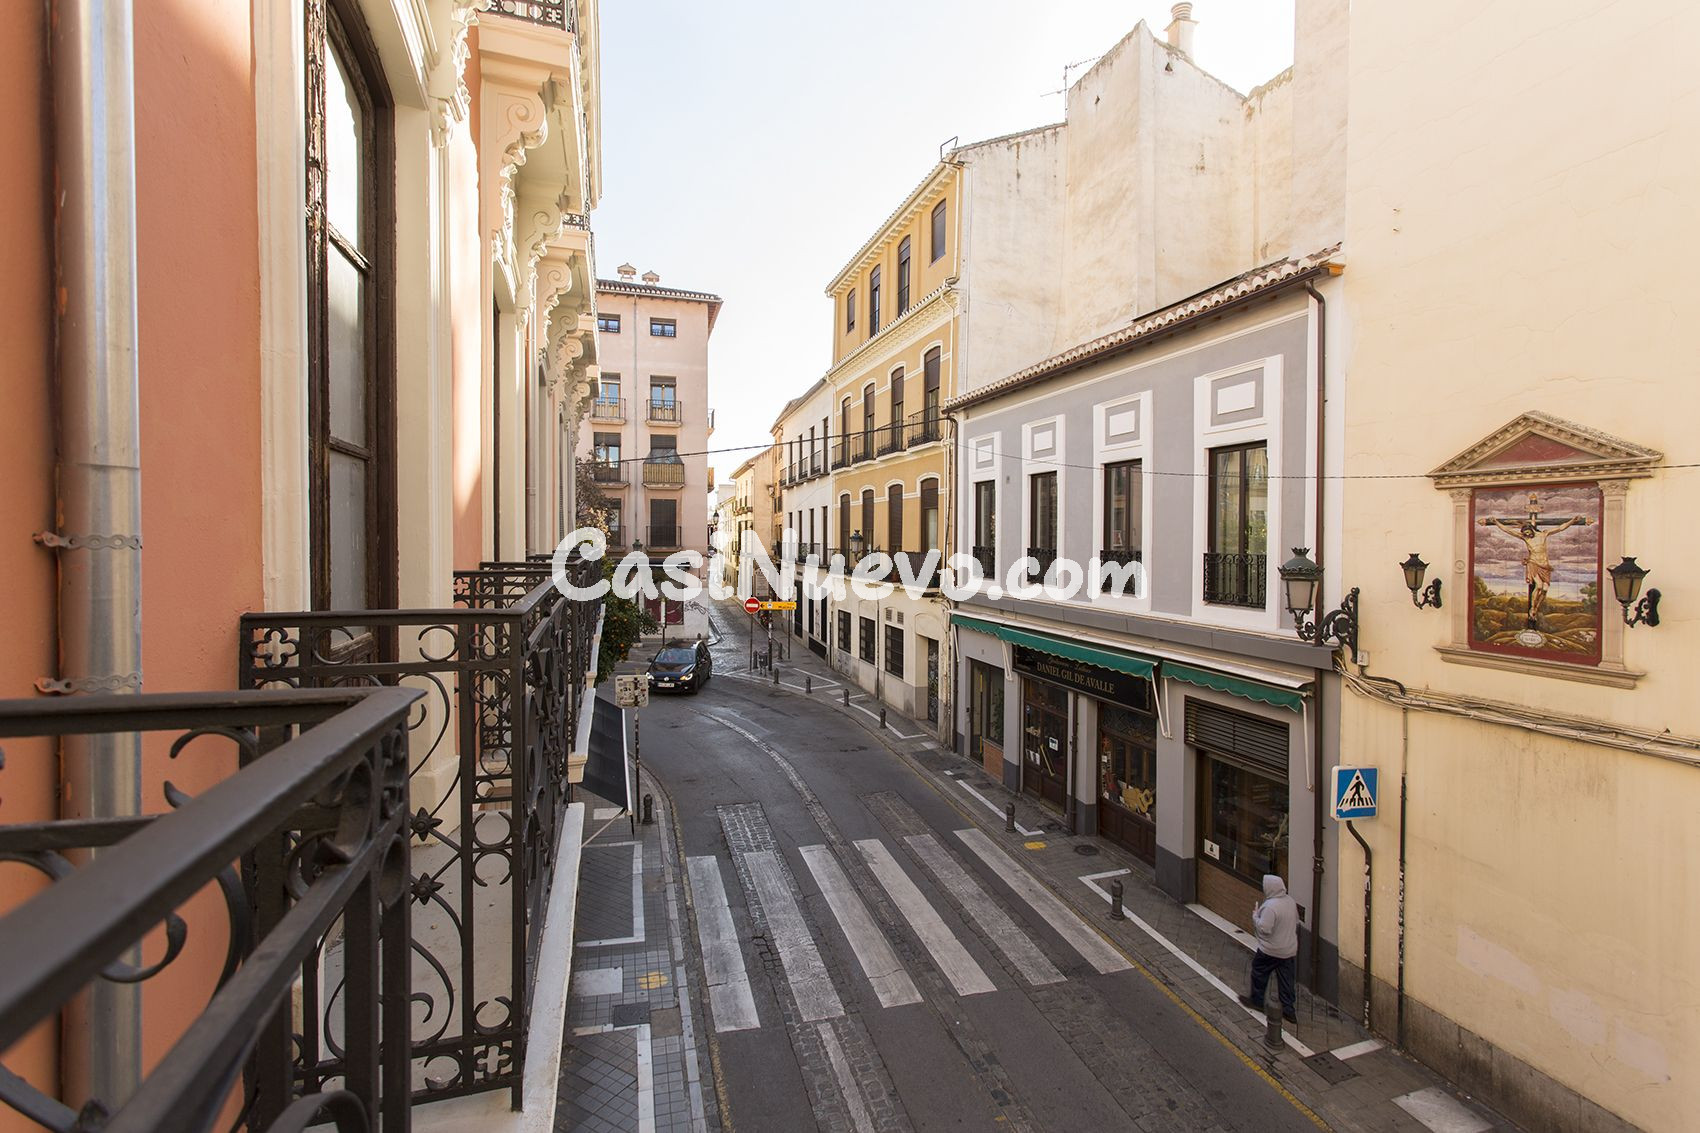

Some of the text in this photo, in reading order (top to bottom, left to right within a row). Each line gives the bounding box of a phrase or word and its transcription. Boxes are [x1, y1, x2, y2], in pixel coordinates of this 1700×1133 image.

[1037, 662, 1060, 677] DANIEL
[1061, 669, 1074, 681] GIL
[1074, 672, 1085, 685] DE
[1086, 677, 1115, 694] AVALLE
